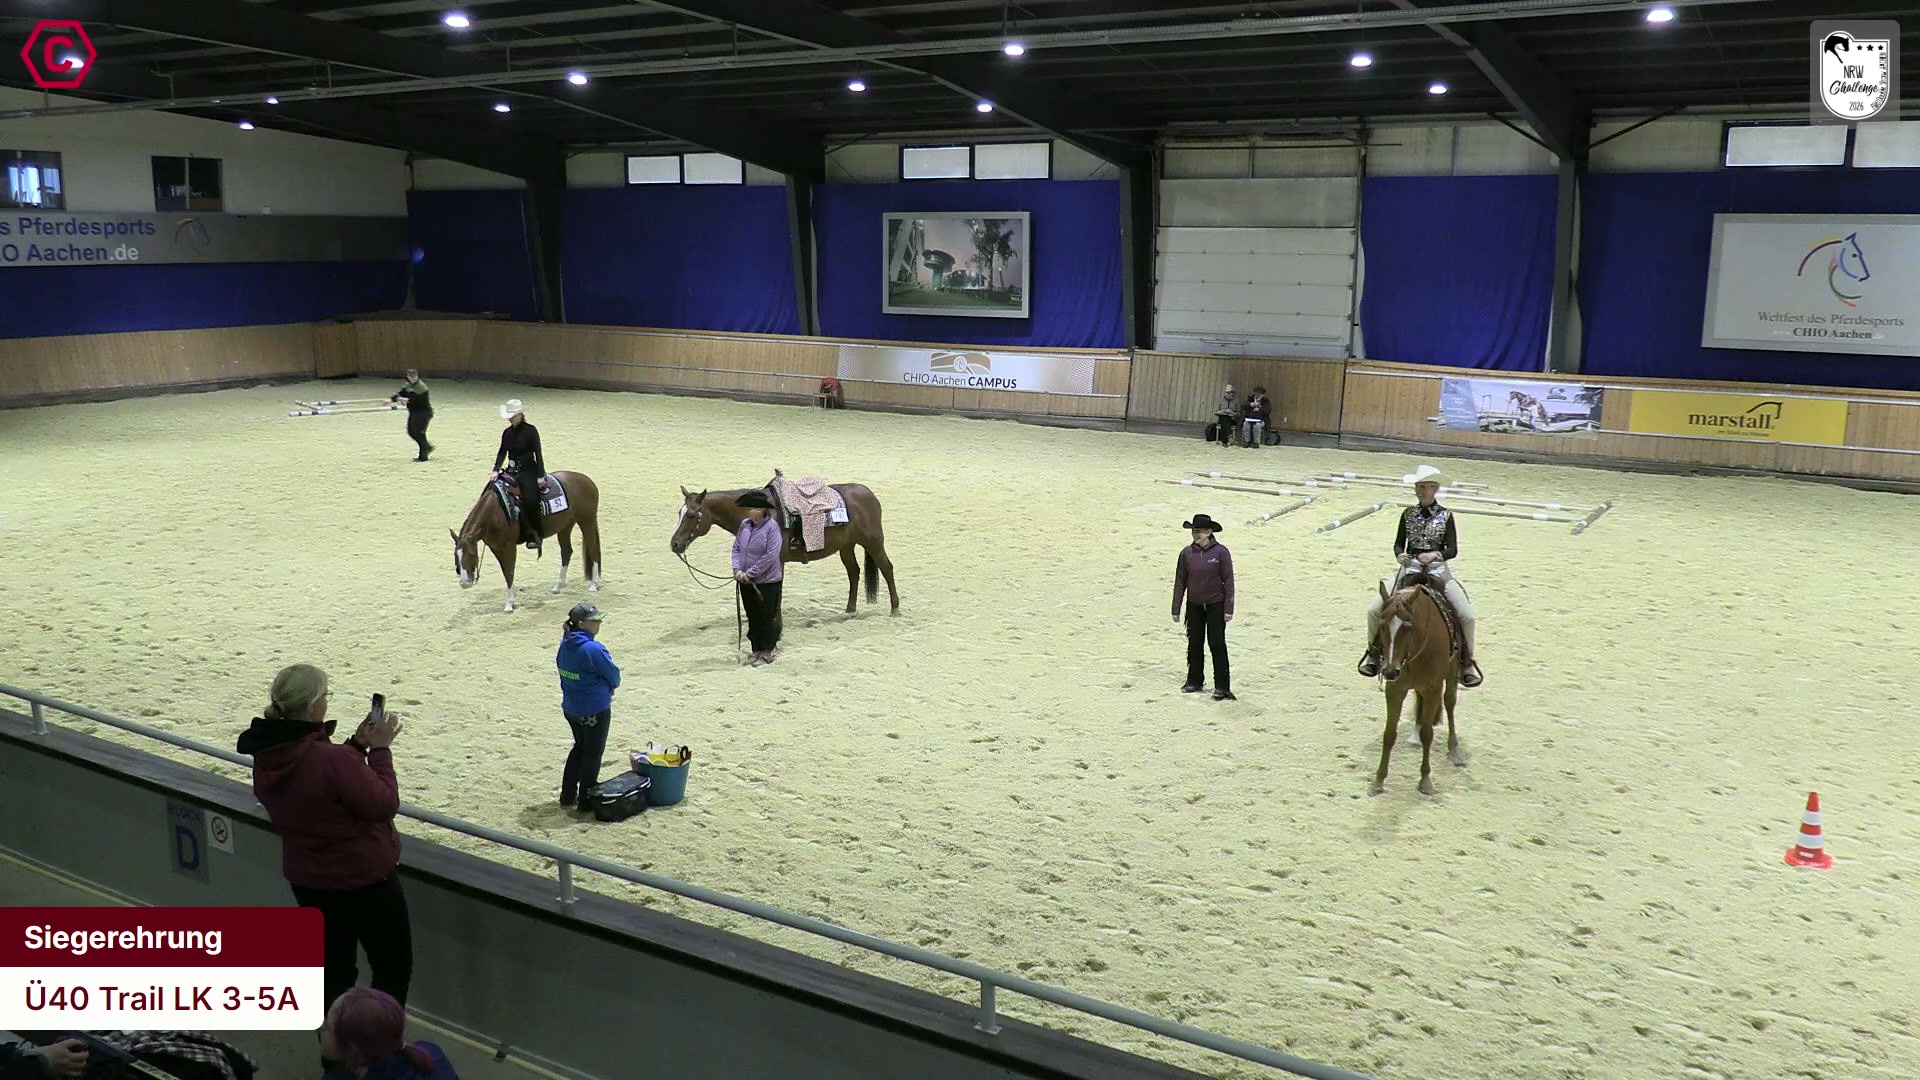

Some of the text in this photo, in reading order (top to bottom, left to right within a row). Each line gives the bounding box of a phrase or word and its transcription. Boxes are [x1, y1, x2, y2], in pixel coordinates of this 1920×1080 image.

[18, 217, 156, 239] Pferdesports
[27, 243, 140, 262] Aachen.de
[1757, 311, 1905, 328] Weltfest des Pferdesports
[1793, 327, 1873, 340] CHIO Aachen
[903, 372, 1018, 389] CHIO Aachen CAMPUS
[1687, 413, 1772, 430] marstall
[176, 825, 200, 870] D
